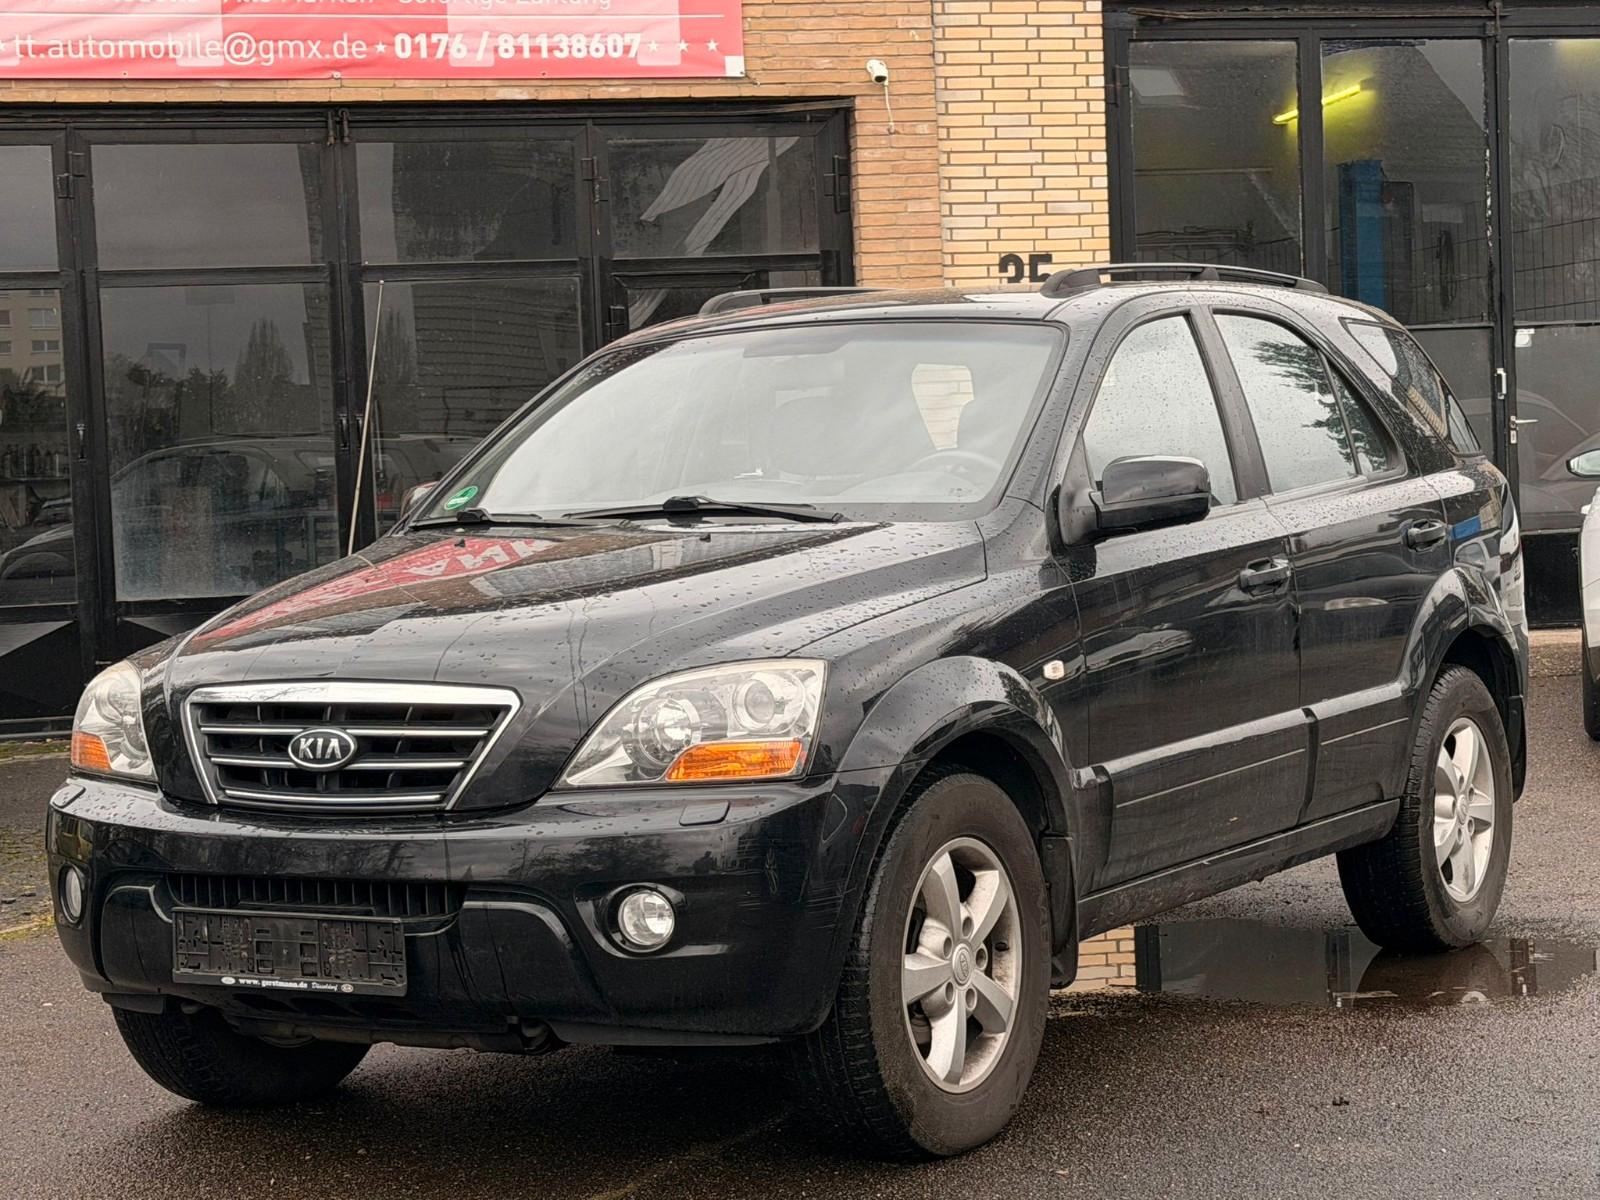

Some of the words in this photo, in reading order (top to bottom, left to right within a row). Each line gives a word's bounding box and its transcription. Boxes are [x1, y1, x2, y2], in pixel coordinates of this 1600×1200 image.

[14, 31, 368, 66] tt.automobile@gmx.de
[393, 32, 467, 60] 0176
[474, 31, 490, 61] /
[497, 32, 642, 60] 81138607
[298, 737, 342, 760] KIA
